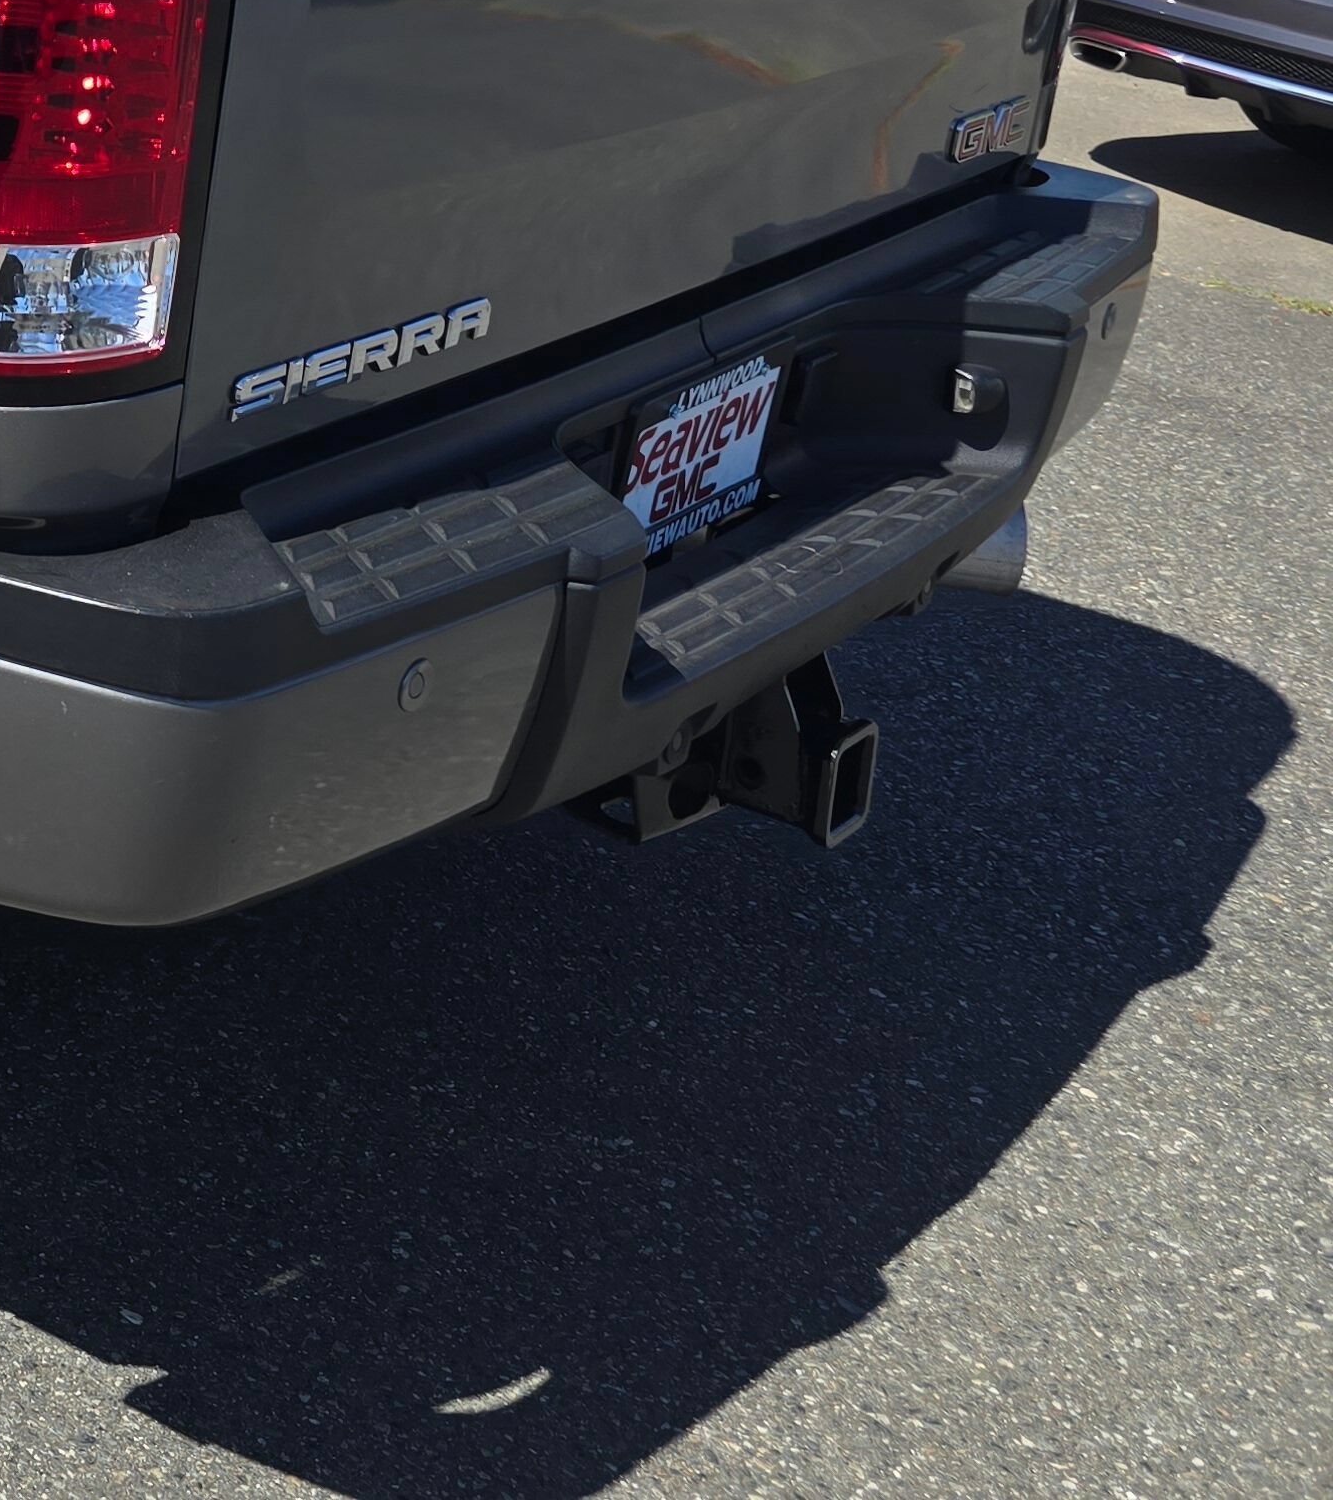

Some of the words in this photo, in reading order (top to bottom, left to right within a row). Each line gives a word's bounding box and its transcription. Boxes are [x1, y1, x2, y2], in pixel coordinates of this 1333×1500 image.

[951, 95, 1031, 164] GMC
[230, 297, 492, 422] SIERRA
[677, 356, 765, 412] LYNNWOOD
[623, 381, 778, 496] Seaview
[649, 453, 721, 524] GMC
